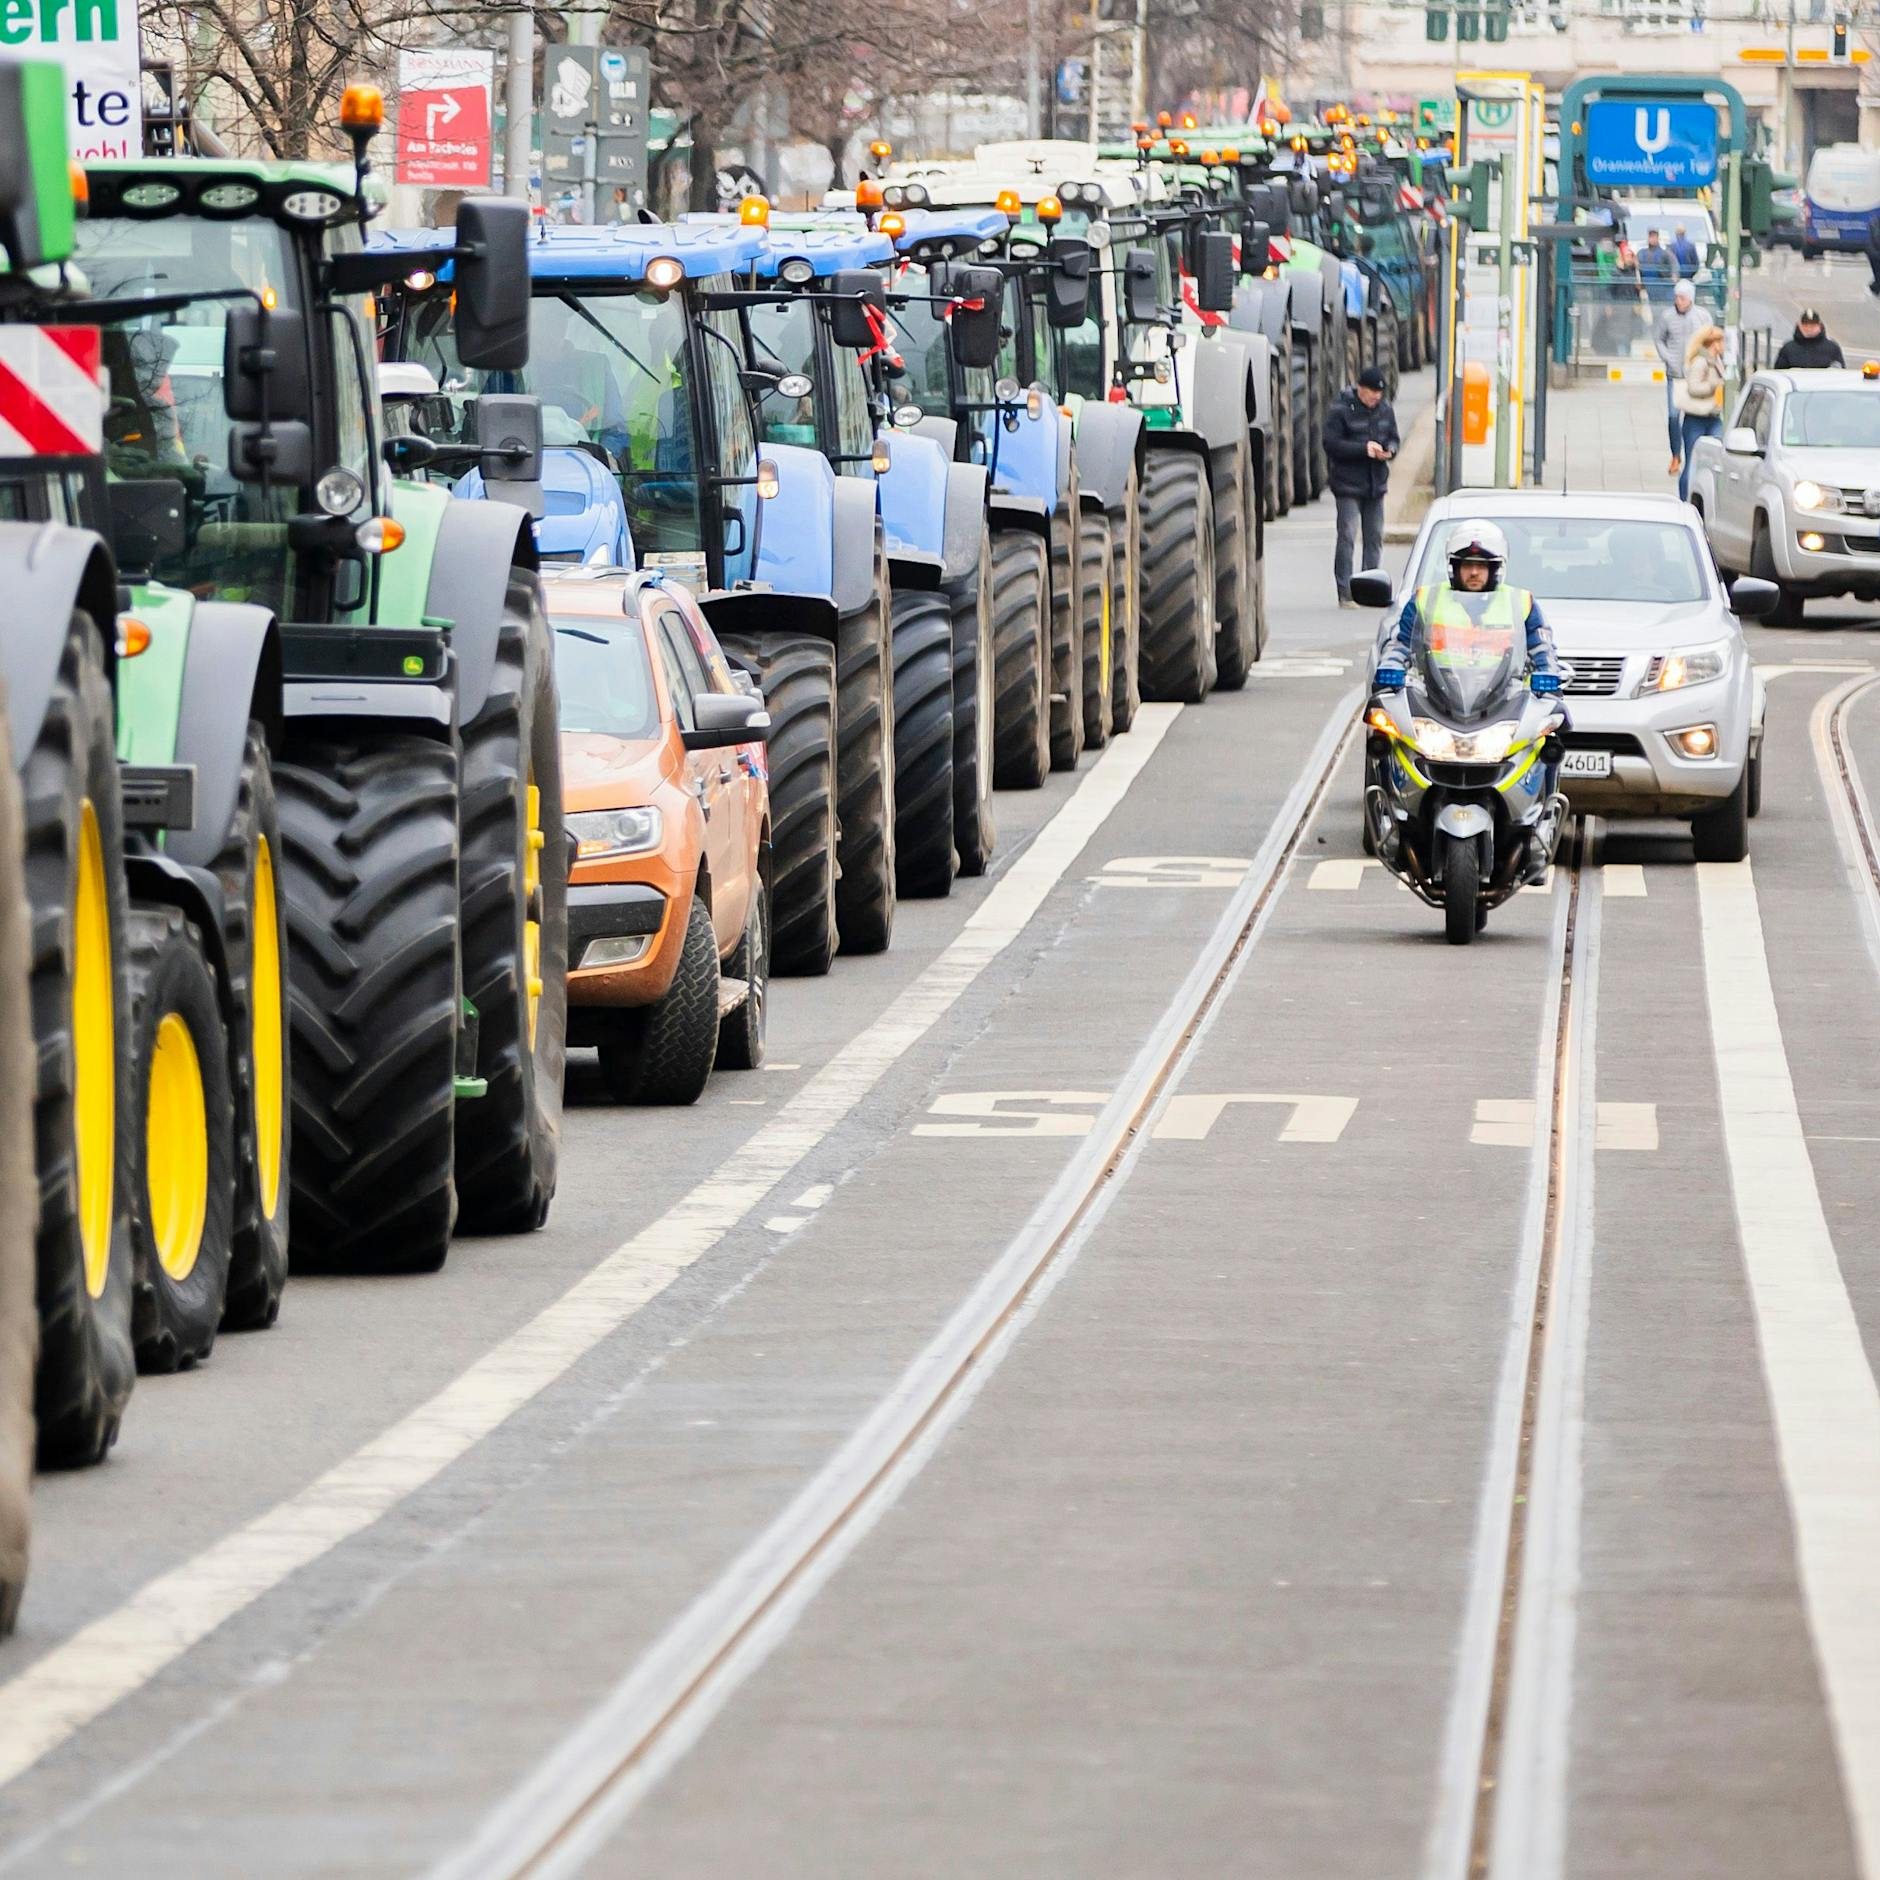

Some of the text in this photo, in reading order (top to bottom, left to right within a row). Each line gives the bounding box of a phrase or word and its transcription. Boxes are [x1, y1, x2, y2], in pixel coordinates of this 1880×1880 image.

[0, 0, 118, 44] ern
[72, 80, 130, 127] te
[1635, 107, 1670, 154] U
[1564, 755, 1608, 773] 4601
